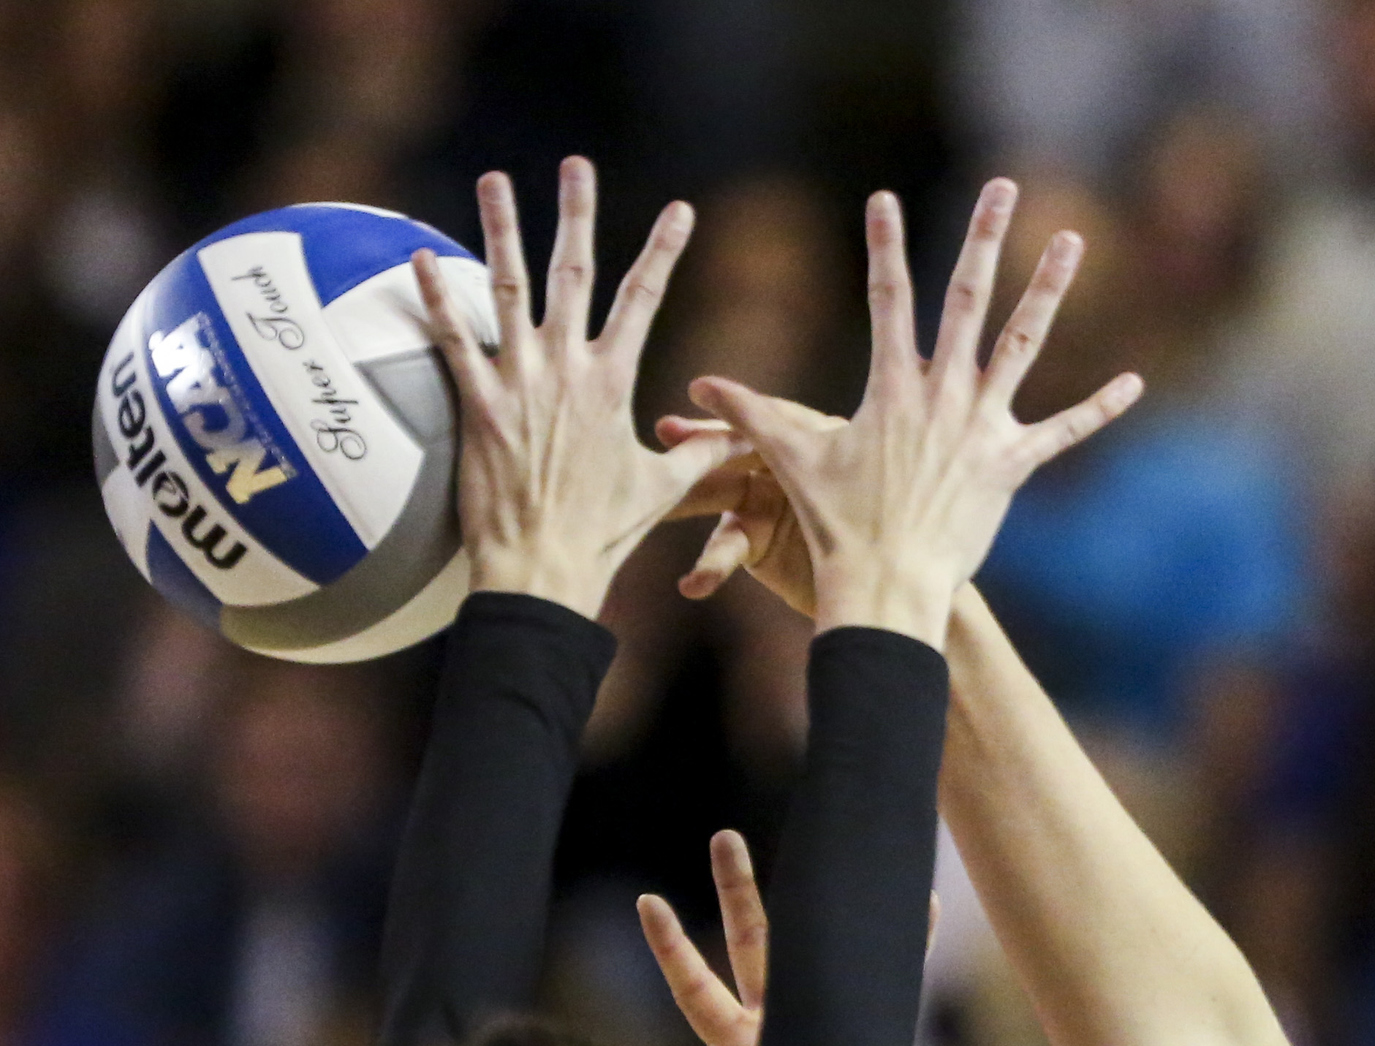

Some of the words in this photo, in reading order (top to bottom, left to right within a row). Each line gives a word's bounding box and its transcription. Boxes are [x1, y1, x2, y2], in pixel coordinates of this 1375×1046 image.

[232, 264, 304, 352] Touch
[110, 350, 249, 570] molten
[302, 360, 367, 462] Super
